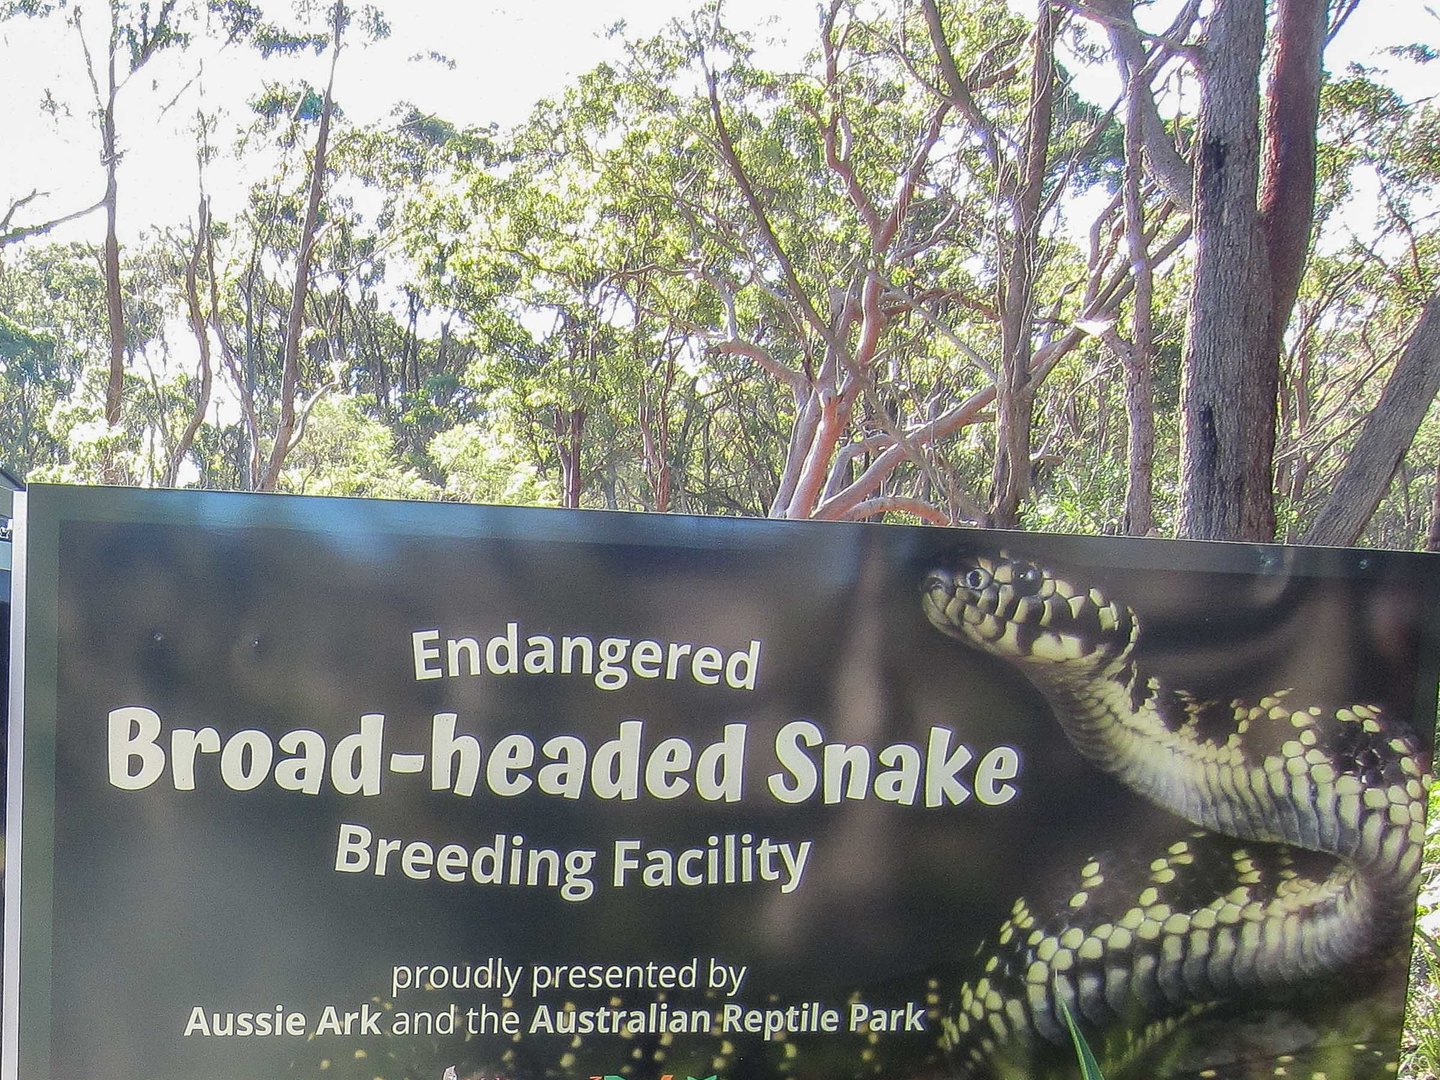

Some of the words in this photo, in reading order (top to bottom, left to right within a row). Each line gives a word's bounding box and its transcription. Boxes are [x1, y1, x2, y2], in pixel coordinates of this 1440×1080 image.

[413, 622, 761, 691] Endangered
[108, 706, 747, 804] Broad-headed
[767, 721, 1020, 808] Snake
[334, 824, 597, 902] Breeding
[613, 833, 813, 894] Facility
[391, 958, 523, 998] proudly
[532, 958, 698, 998] presented
[709, 957, 747, 998] by
[184, 1003, 306, 1038] Aussie
[316, 1003, 381, 1036] Ark
[392, 1003, 457, 1035] and
[466, 1003, 520, 1036] the
[529, 1002, 711, 1034] Australian
[722, 1002, 839, 1041] Reptile
[849, 1002, 926, 1032] Park
